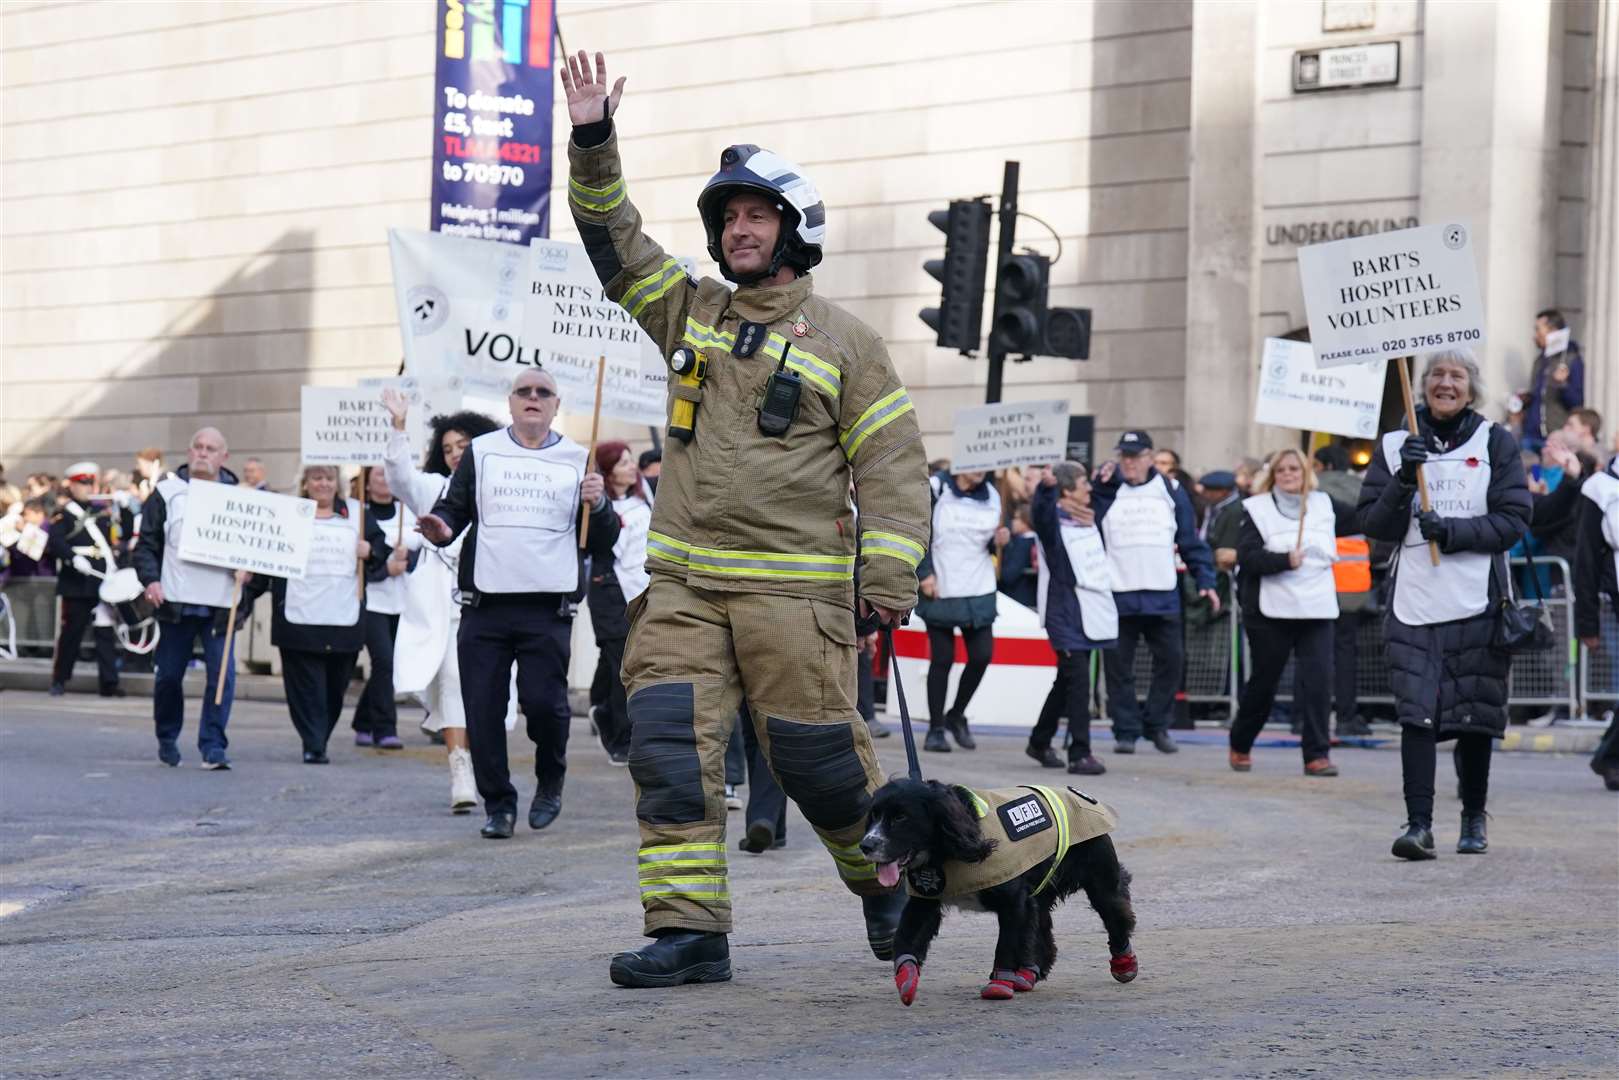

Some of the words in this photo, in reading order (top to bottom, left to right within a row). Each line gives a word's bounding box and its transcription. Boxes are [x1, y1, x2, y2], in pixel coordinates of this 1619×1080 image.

[444, 86, 467, 110] To
[468, 90, 535, 116] donate
[443, 112, 471, 137] £5,
[472, 115, 514, 138] text
[443, 160, 463, 182] to
[463, 162, 525, 187] 70970
[1352, 250, 1421, 277] BART'S
[531, 280, 592, 300] BART'S
[1340, 273, 1441, 304] HOSPITAL
[1327, 294, 1462, 330] VOLUNTEERS
[1320, 350, 1351, 361] PLEASE
[1382, 339, 1406, 352] 020
[1411, 335, 1443, 348] 3765
[1447, 328, 1480, 343] 8700
[327, 415, 390, 427] HOSPITA
[977, 424, 1042, 440] HOSPITAL
[503, 470, 552, 483] BART'S
[1426, 479, 1467, 491] ART'S
[493, 486, 560, 502] HOSPITAL
[225, 499, 277, 519] BART'S
[210, 513, 285, 537] HOSPITAL
[196, 527, 296, 554] VOLUNTEERS
[1011, 803, 1039, 822] LFB
